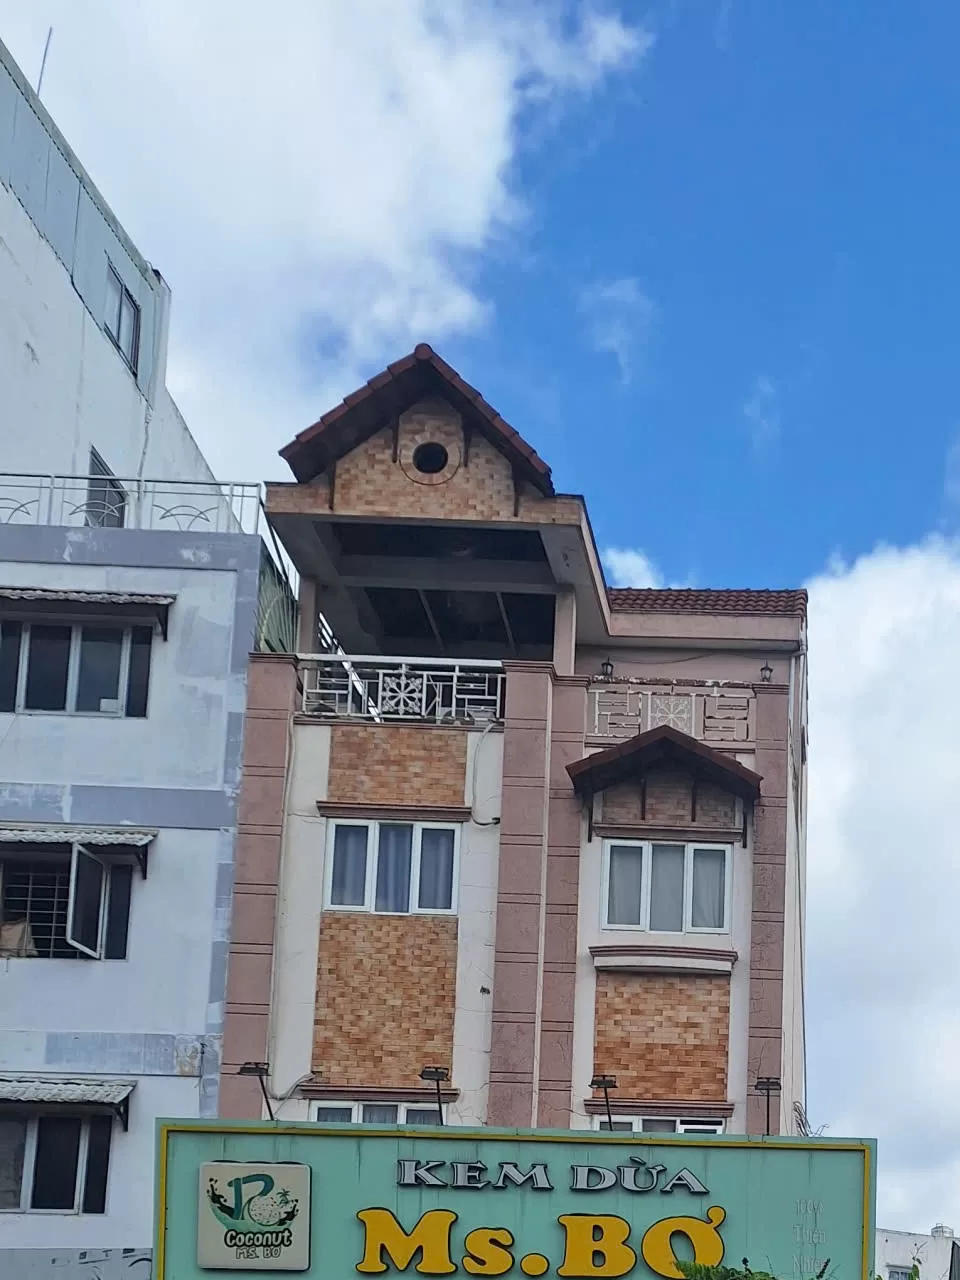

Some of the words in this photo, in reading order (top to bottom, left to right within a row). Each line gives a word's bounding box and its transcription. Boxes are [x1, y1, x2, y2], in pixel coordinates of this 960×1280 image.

[397, 1159, 554, 1190] KEM
[569, 1156, 710, 1193] DỪA
[224, 1229, 292, 1247] Coconut
